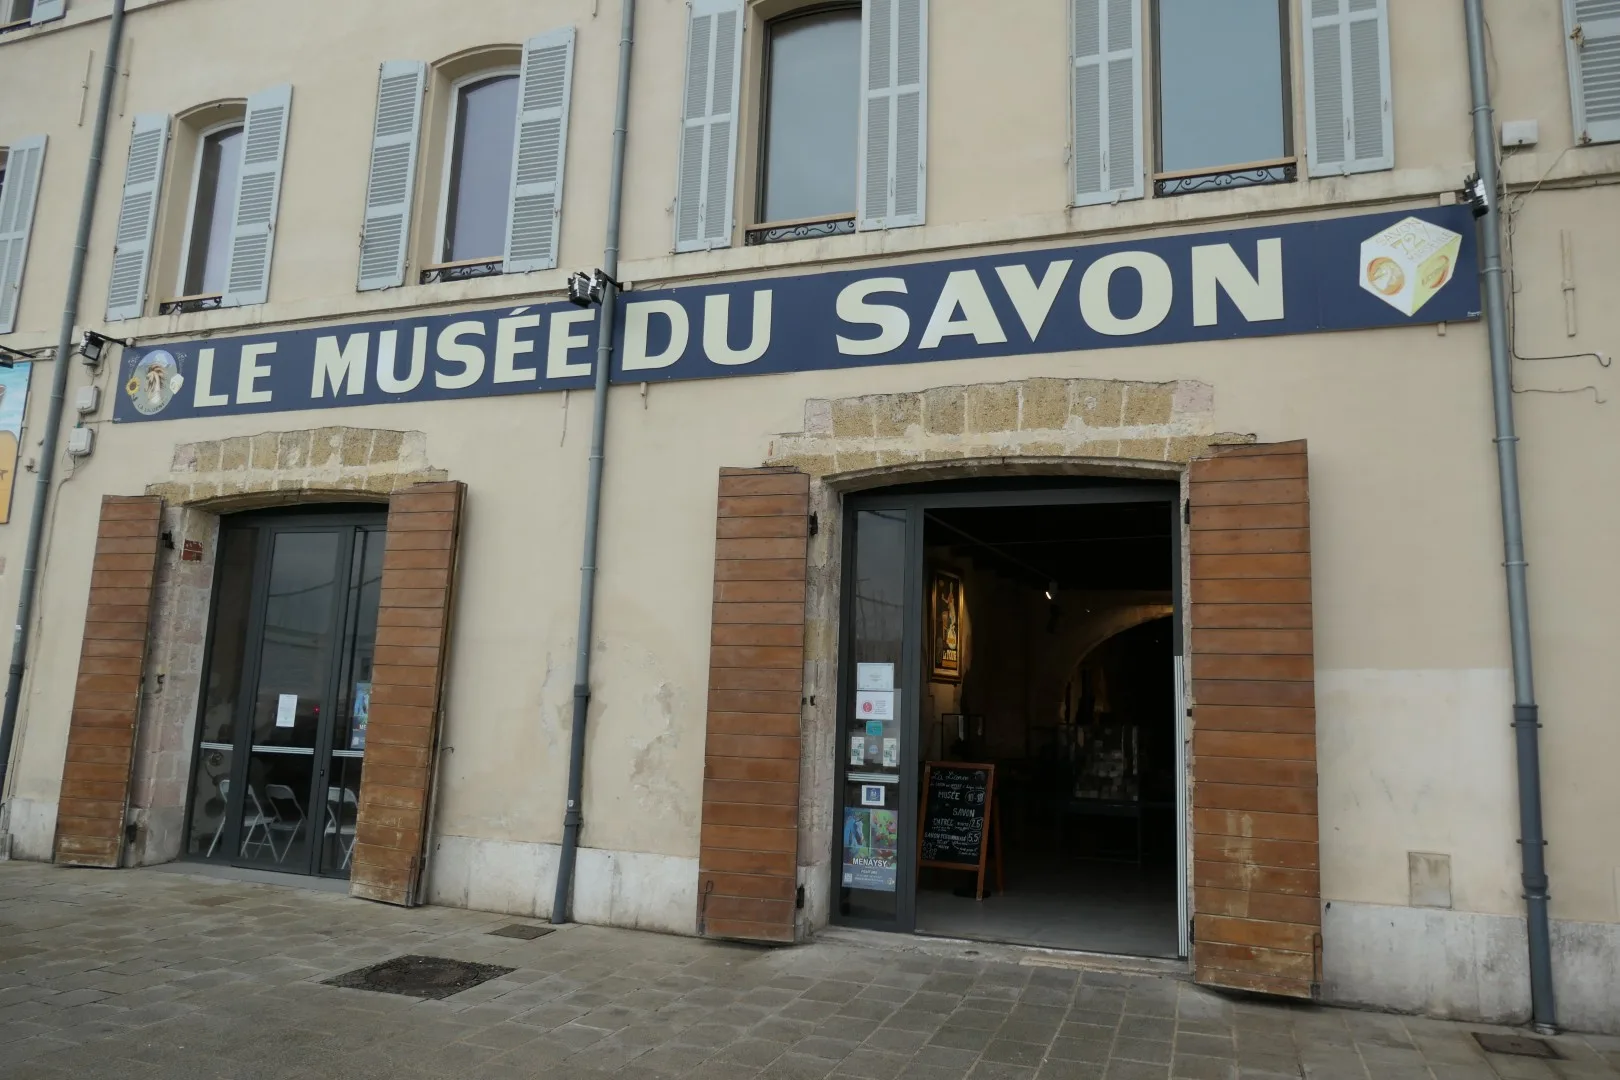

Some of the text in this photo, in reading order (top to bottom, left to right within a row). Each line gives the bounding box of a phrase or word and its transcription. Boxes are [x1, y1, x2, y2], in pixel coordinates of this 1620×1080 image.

[193, 238, 1284, 407] LE MUSÉE DU SAVON
[853, 857, 888, 868] MENAYSY
